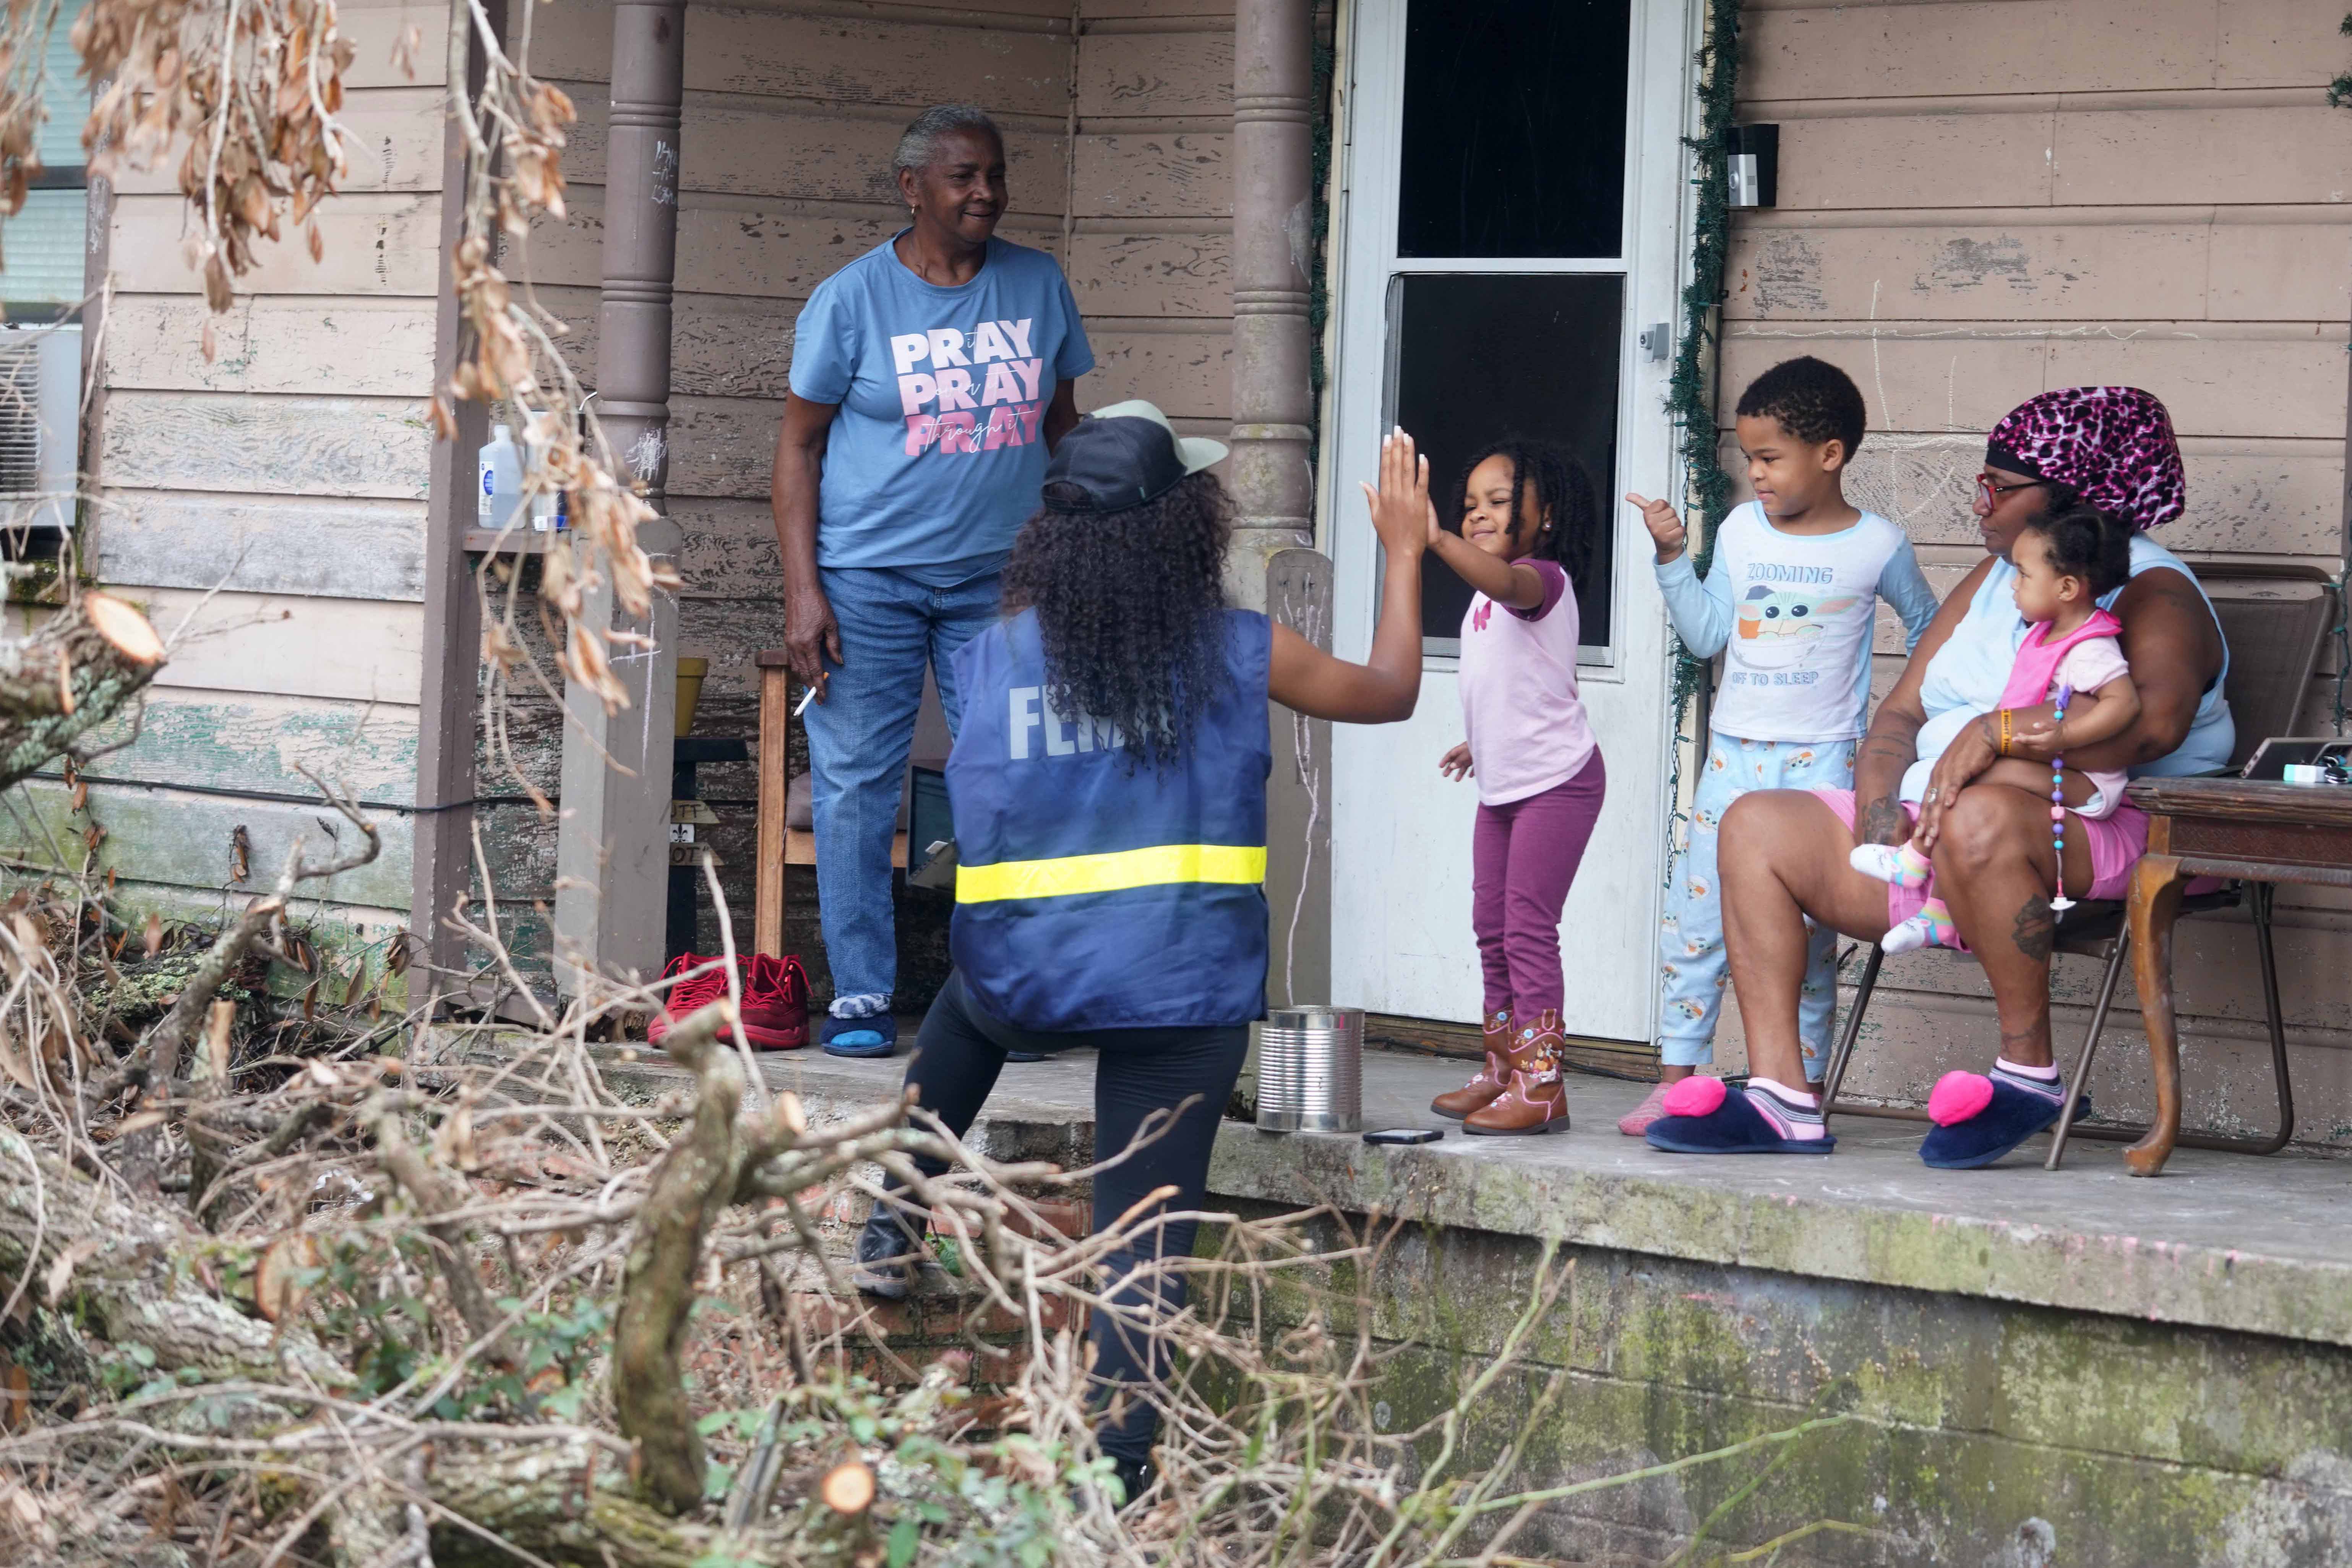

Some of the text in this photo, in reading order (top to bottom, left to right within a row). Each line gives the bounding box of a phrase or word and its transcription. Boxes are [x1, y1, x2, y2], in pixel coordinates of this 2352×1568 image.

[891, 318, 1032, 374] PRAY
[898, 358, 1043, 415] PRAY
[905, 401, 1044, 456] PRAY
[921, 407, 1036, 453] through it
[1746, 563, 1833, 584] ZOOMING
[1732, 671, 1819, 686] OFF TO SLEEP
